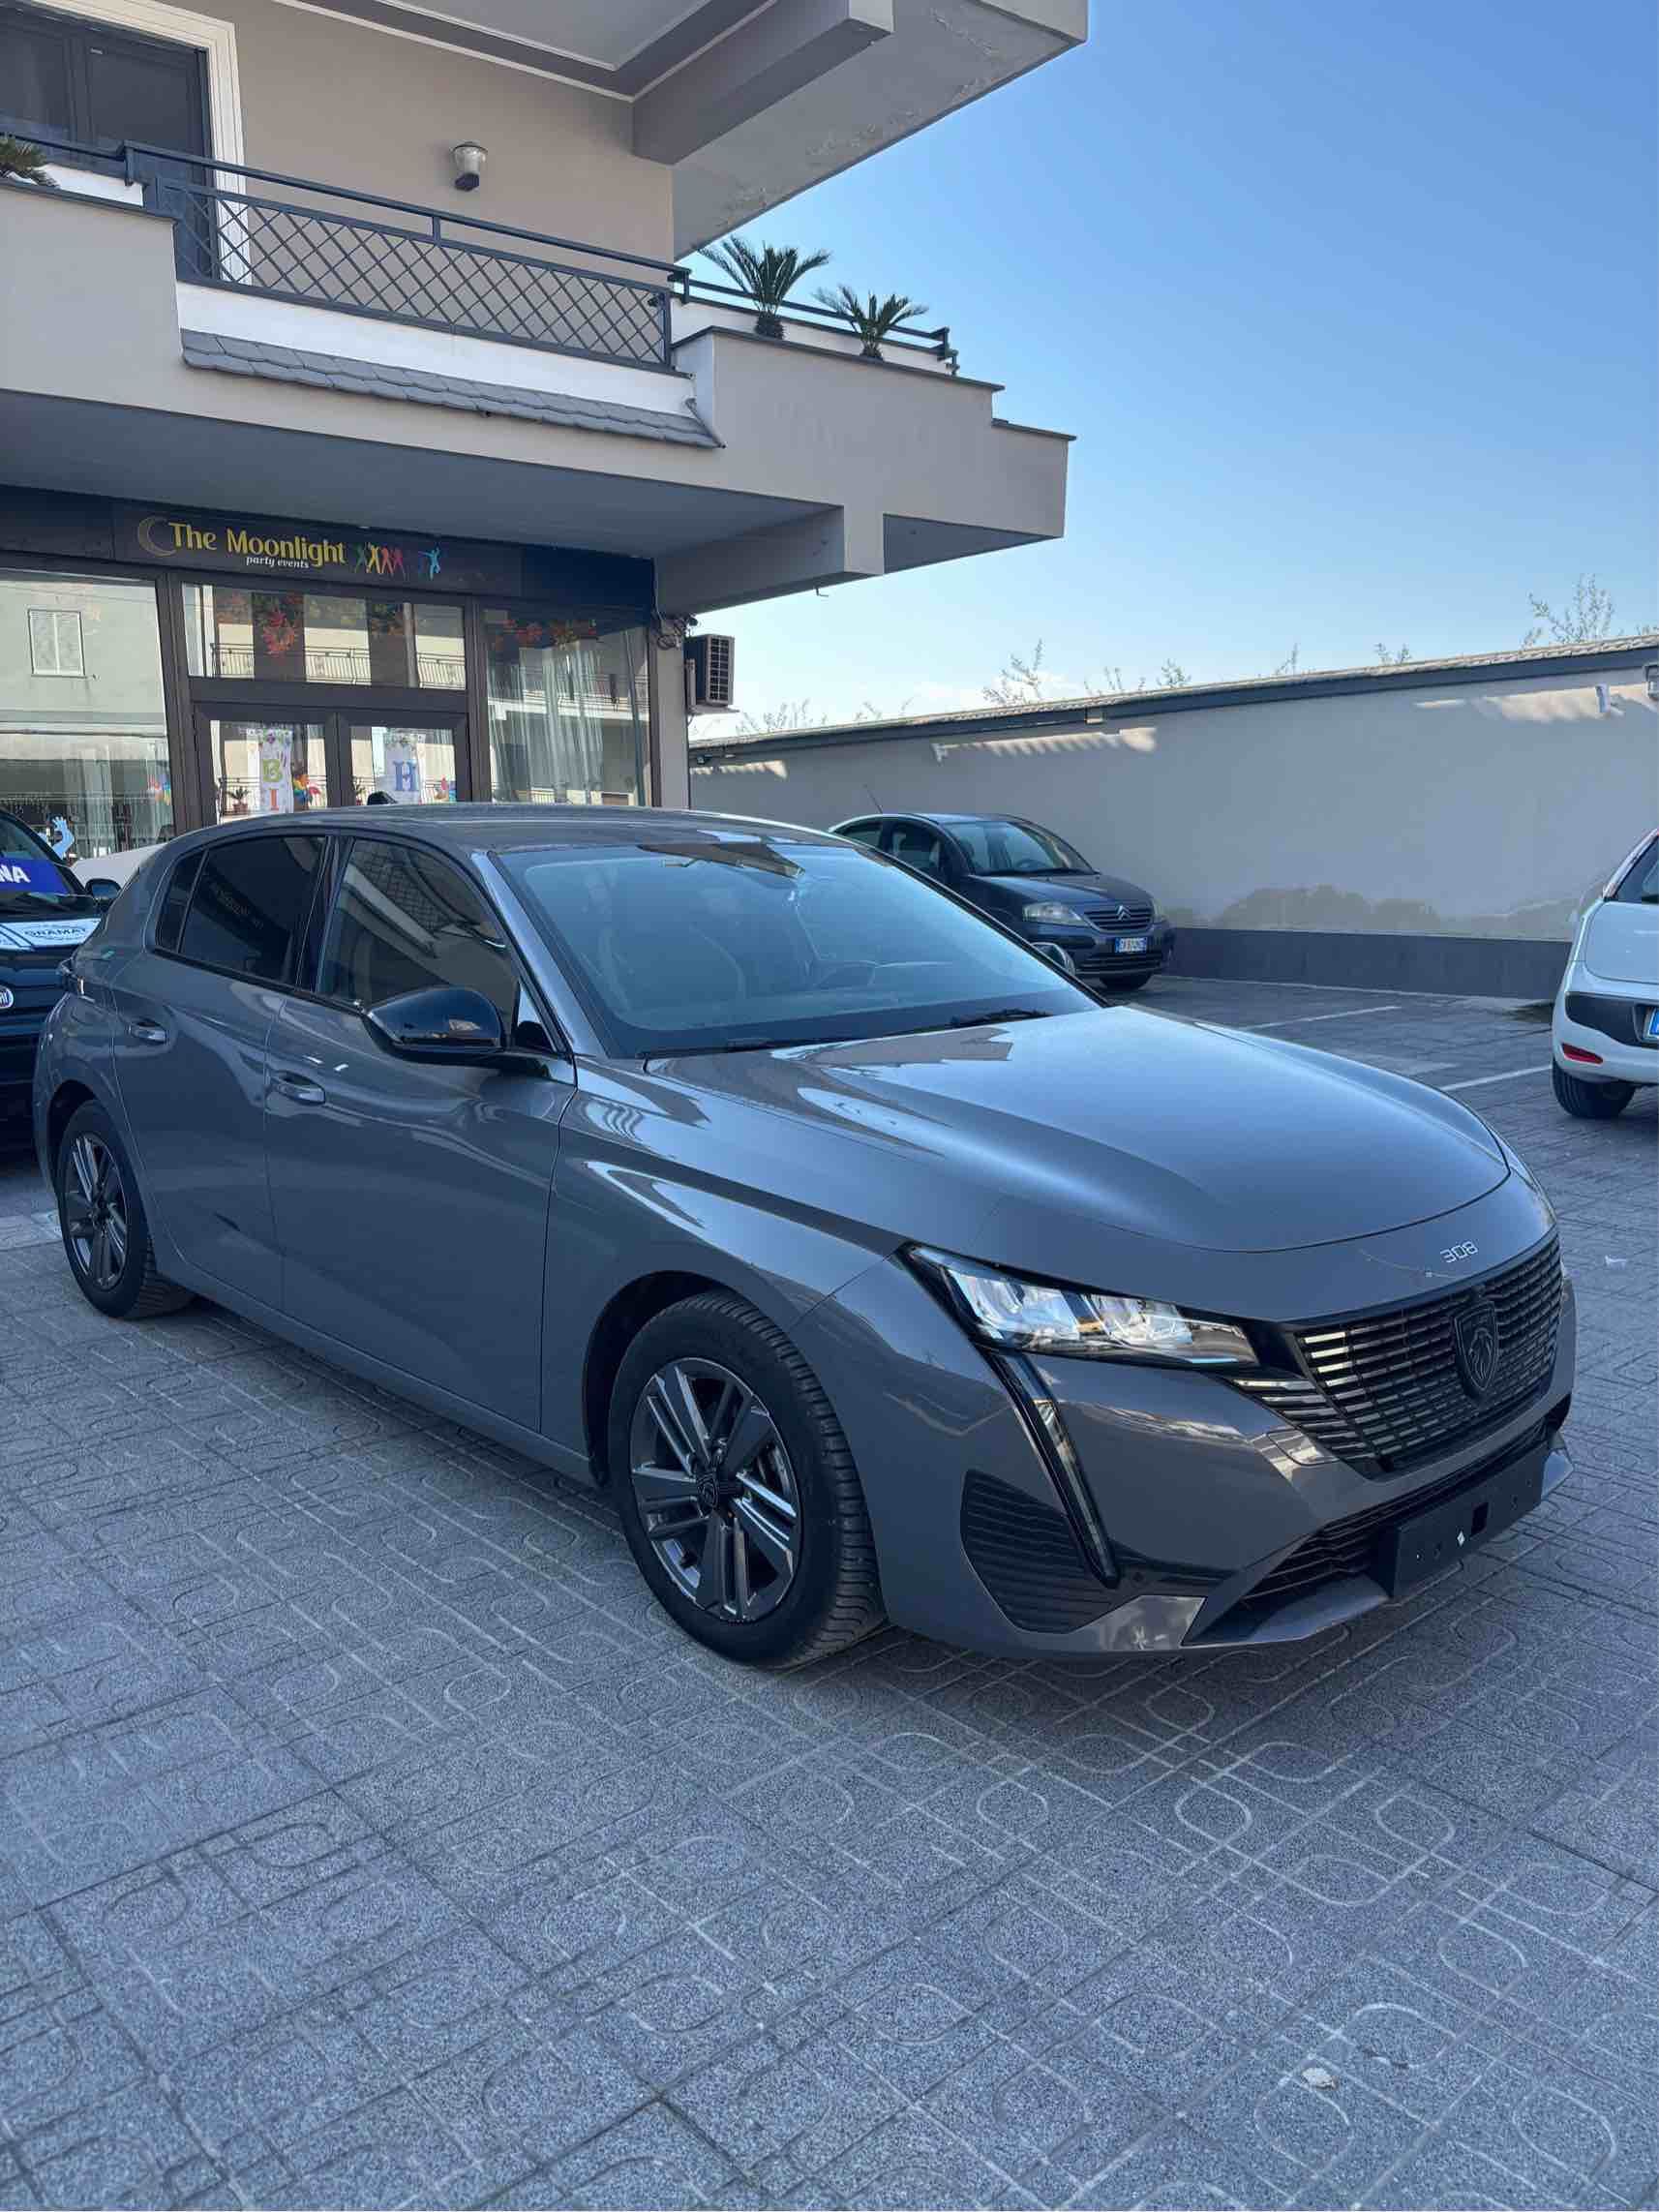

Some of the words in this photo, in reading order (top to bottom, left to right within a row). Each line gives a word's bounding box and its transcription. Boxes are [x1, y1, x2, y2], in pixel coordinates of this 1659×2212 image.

[168, 522, 217, 550] The
[226, 528, 347, 567] Moonlight
[246, 555, 275, 568] party
[277, 557, 310, 569] events
[1440, 1241, 1478, 1263] 308
